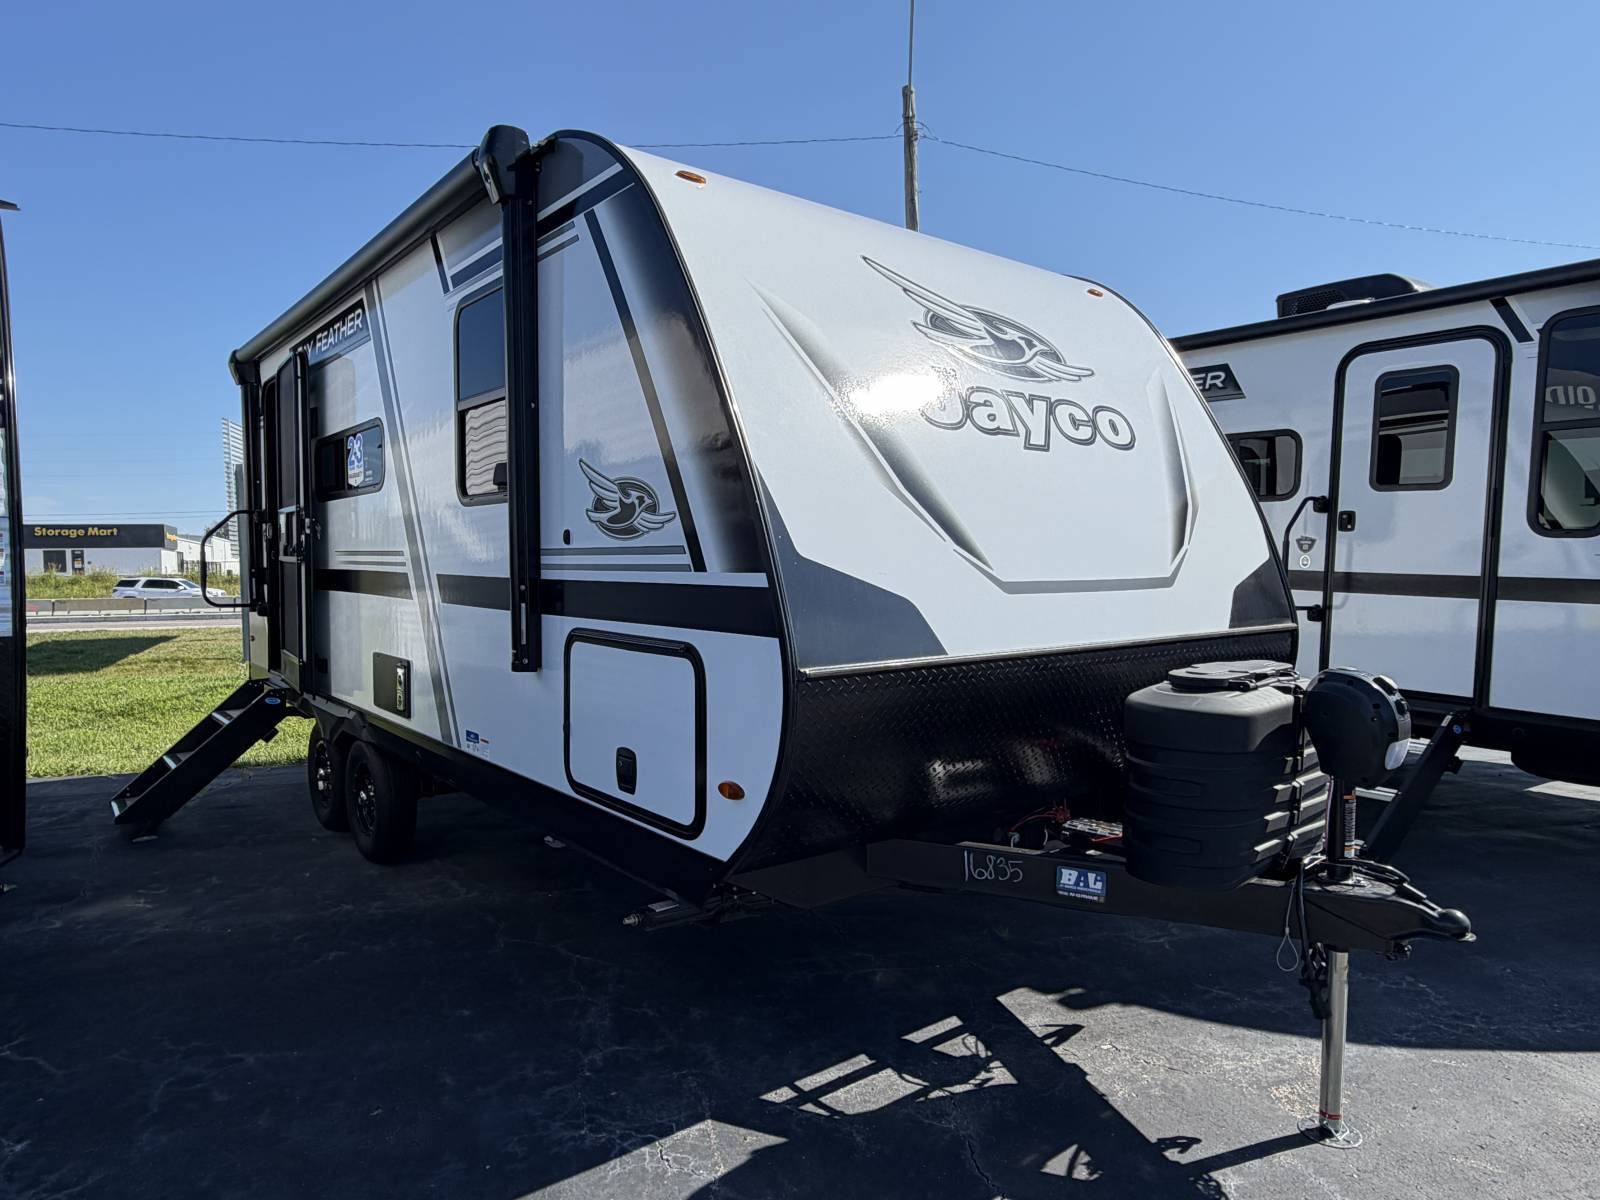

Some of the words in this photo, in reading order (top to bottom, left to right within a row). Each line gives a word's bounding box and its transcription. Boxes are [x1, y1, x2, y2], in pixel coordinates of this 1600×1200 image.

[316, 308, 362, 355] FEATHER
[918, 384, 1136, 452] Jayco
[34, 526, 85, 538] Storage
[87, 526, 119, 536] Mart
[964, 850, 1024, 883] 16835
